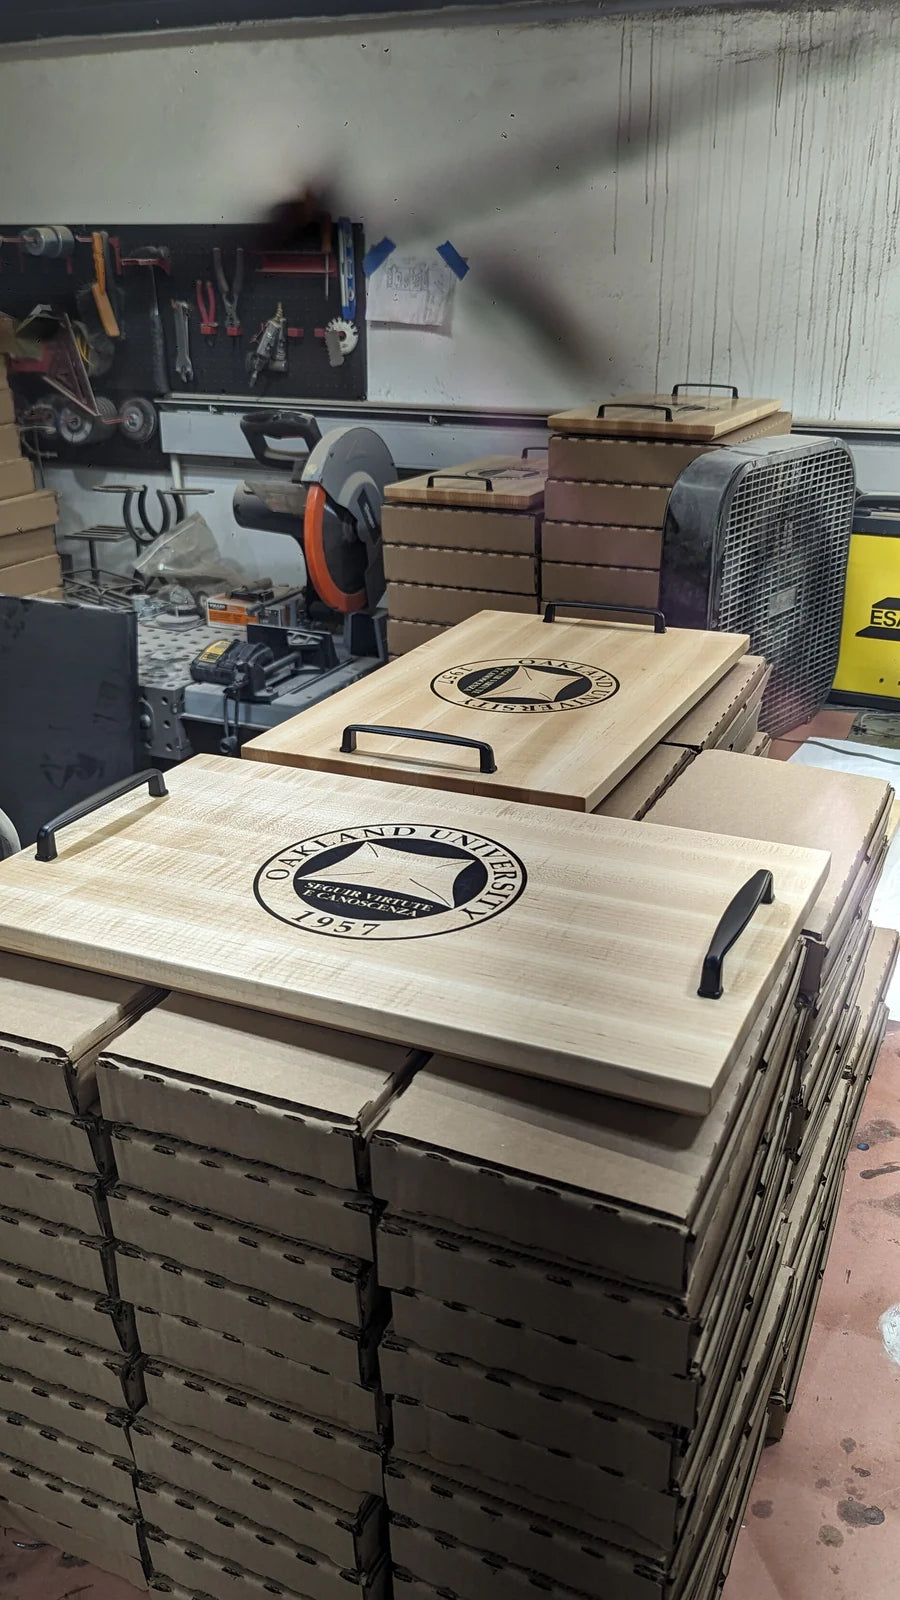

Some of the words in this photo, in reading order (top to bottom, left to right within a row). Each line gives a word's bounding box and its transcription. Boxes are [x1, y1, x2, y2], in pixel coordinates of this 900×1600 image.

[870, 609, 900, 628] ES
[438, 667, 472, 684] 1957
[519, 659, 613, 687] OAKLAND
[457, 689, 611, 711] UNIVERSITY
[266, 827, 416, 880] OAKLAND
[429, 829, 517, 920] UNIVERSITY
[302, 889, 315, 897] E
[316, 891, 418, 918] CANOSCENZA
[304, 881, 363, 898] SEGUIR
[365, 893, 434, 912] VIRTUTE
[291, 910, 381, 936] 1957
